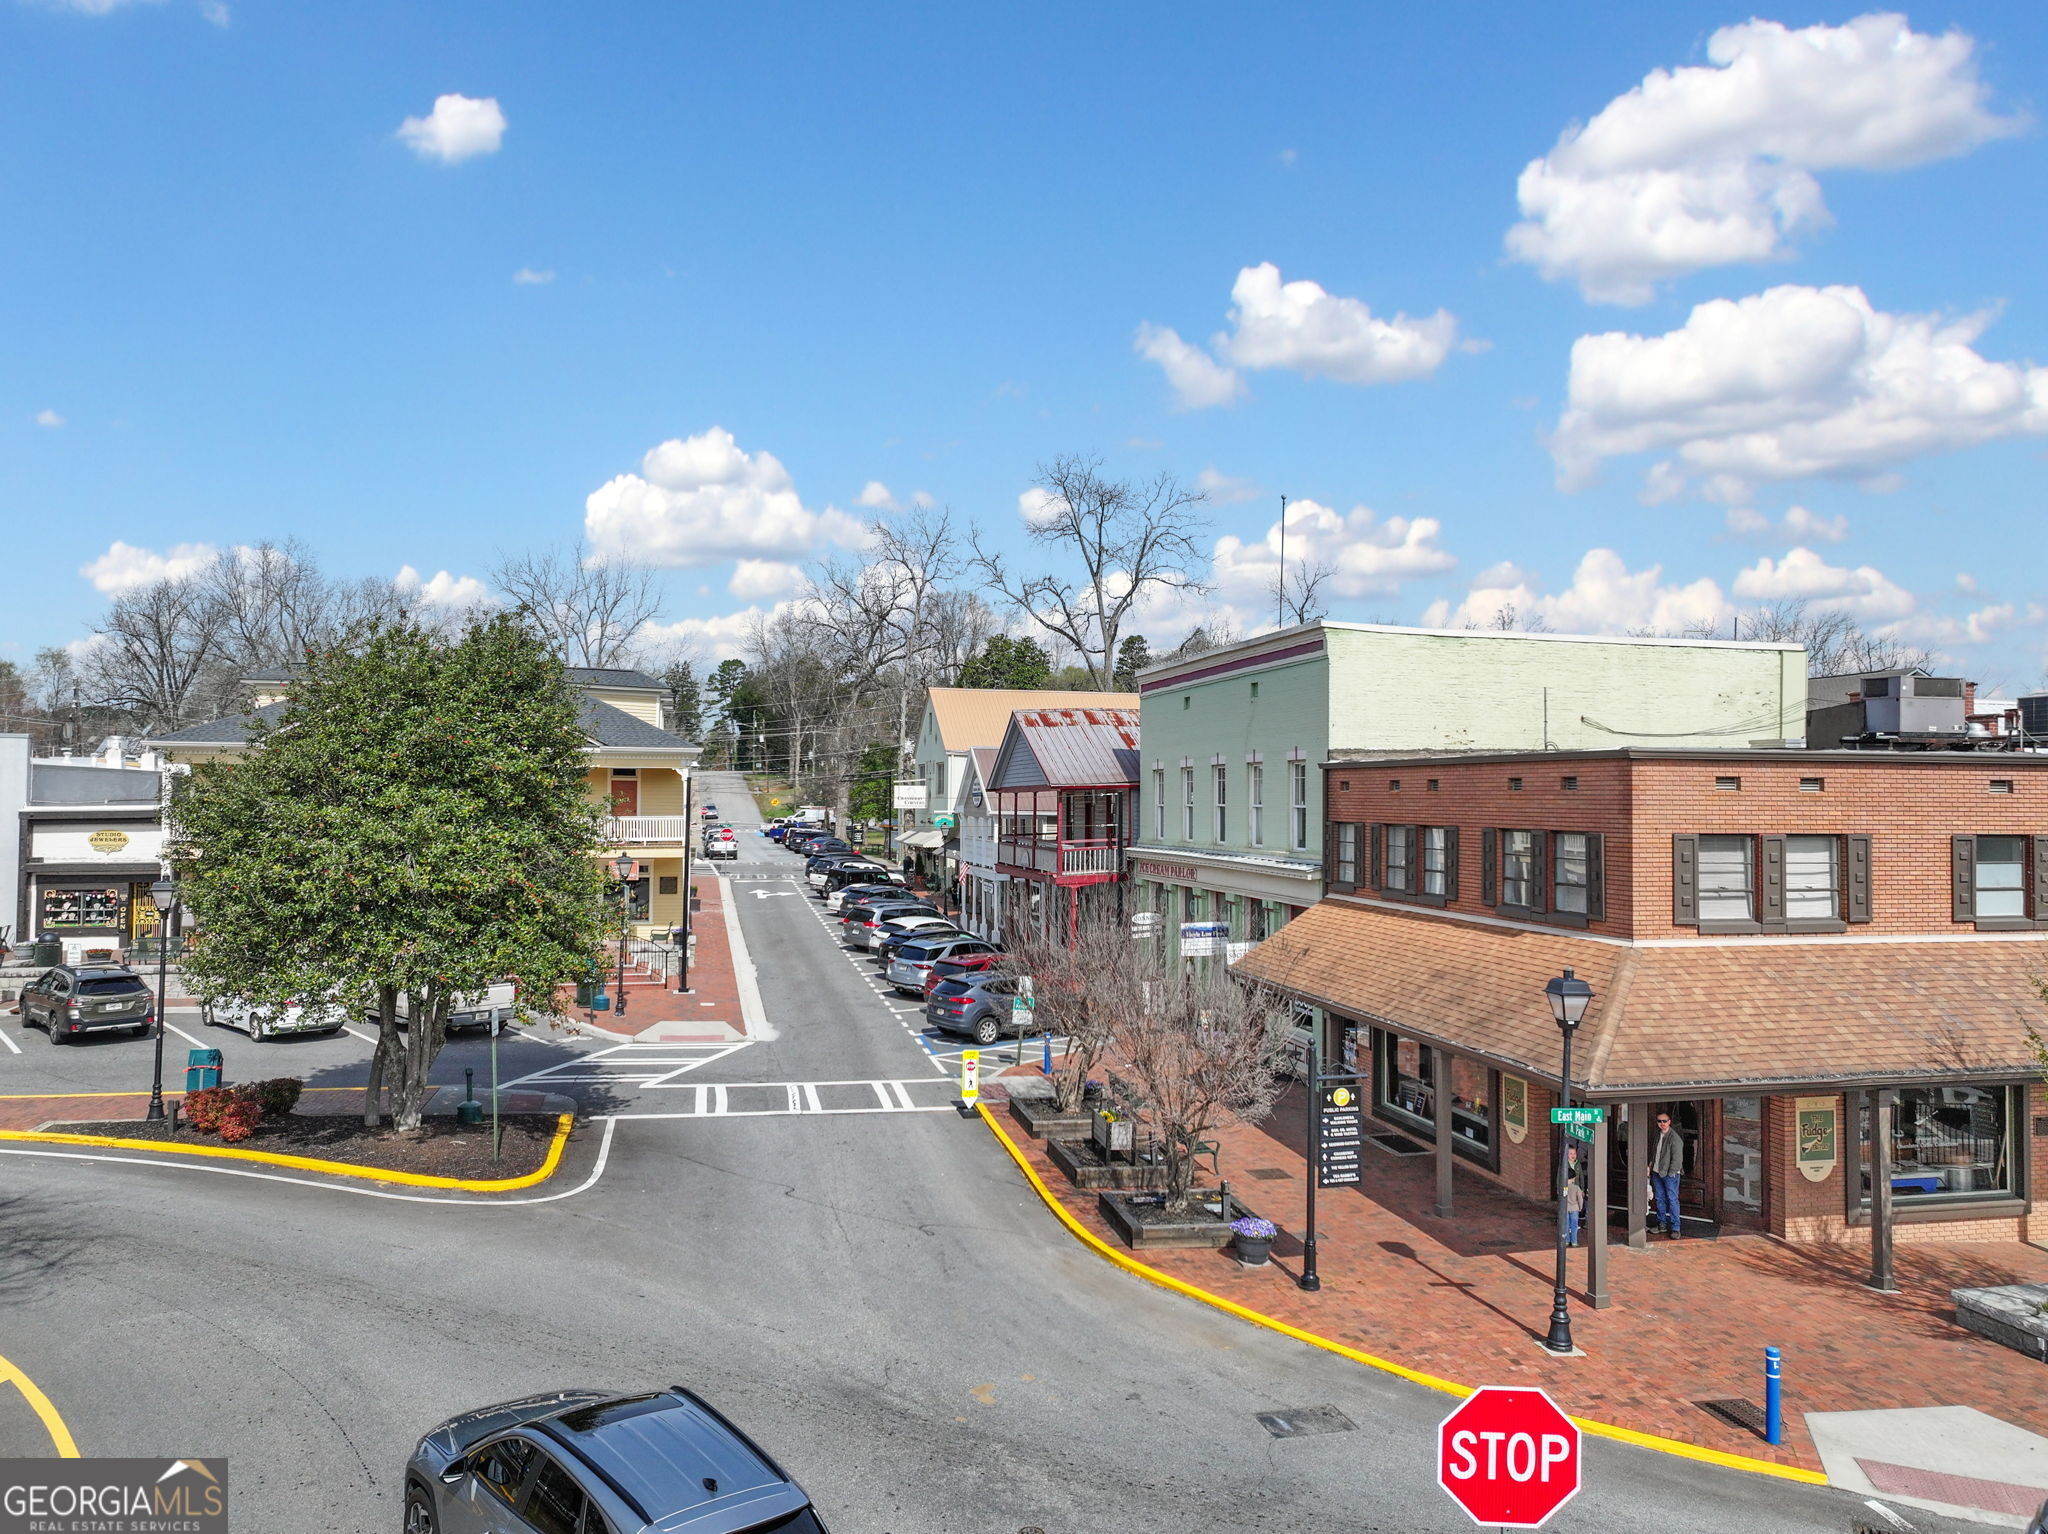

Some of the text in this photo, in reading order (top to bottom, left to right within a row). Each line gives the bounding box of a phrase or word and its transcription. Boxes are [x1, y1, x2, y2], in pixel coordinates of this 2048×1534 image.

[1149, 863, 1170, 877] CREAM
[1170, 866, 1196, 880] PARLOR
[119, 906, 127, 930] OPEN
[1557, 1110, 1572, 1121] East
[1574, 1110, 1592, 1121] Main
[1575, 1125, 1585, 1139] Park
[1801, 1122, 1829, 1143] Fudge
[1449, 1430, 1570, 1482] STOP
